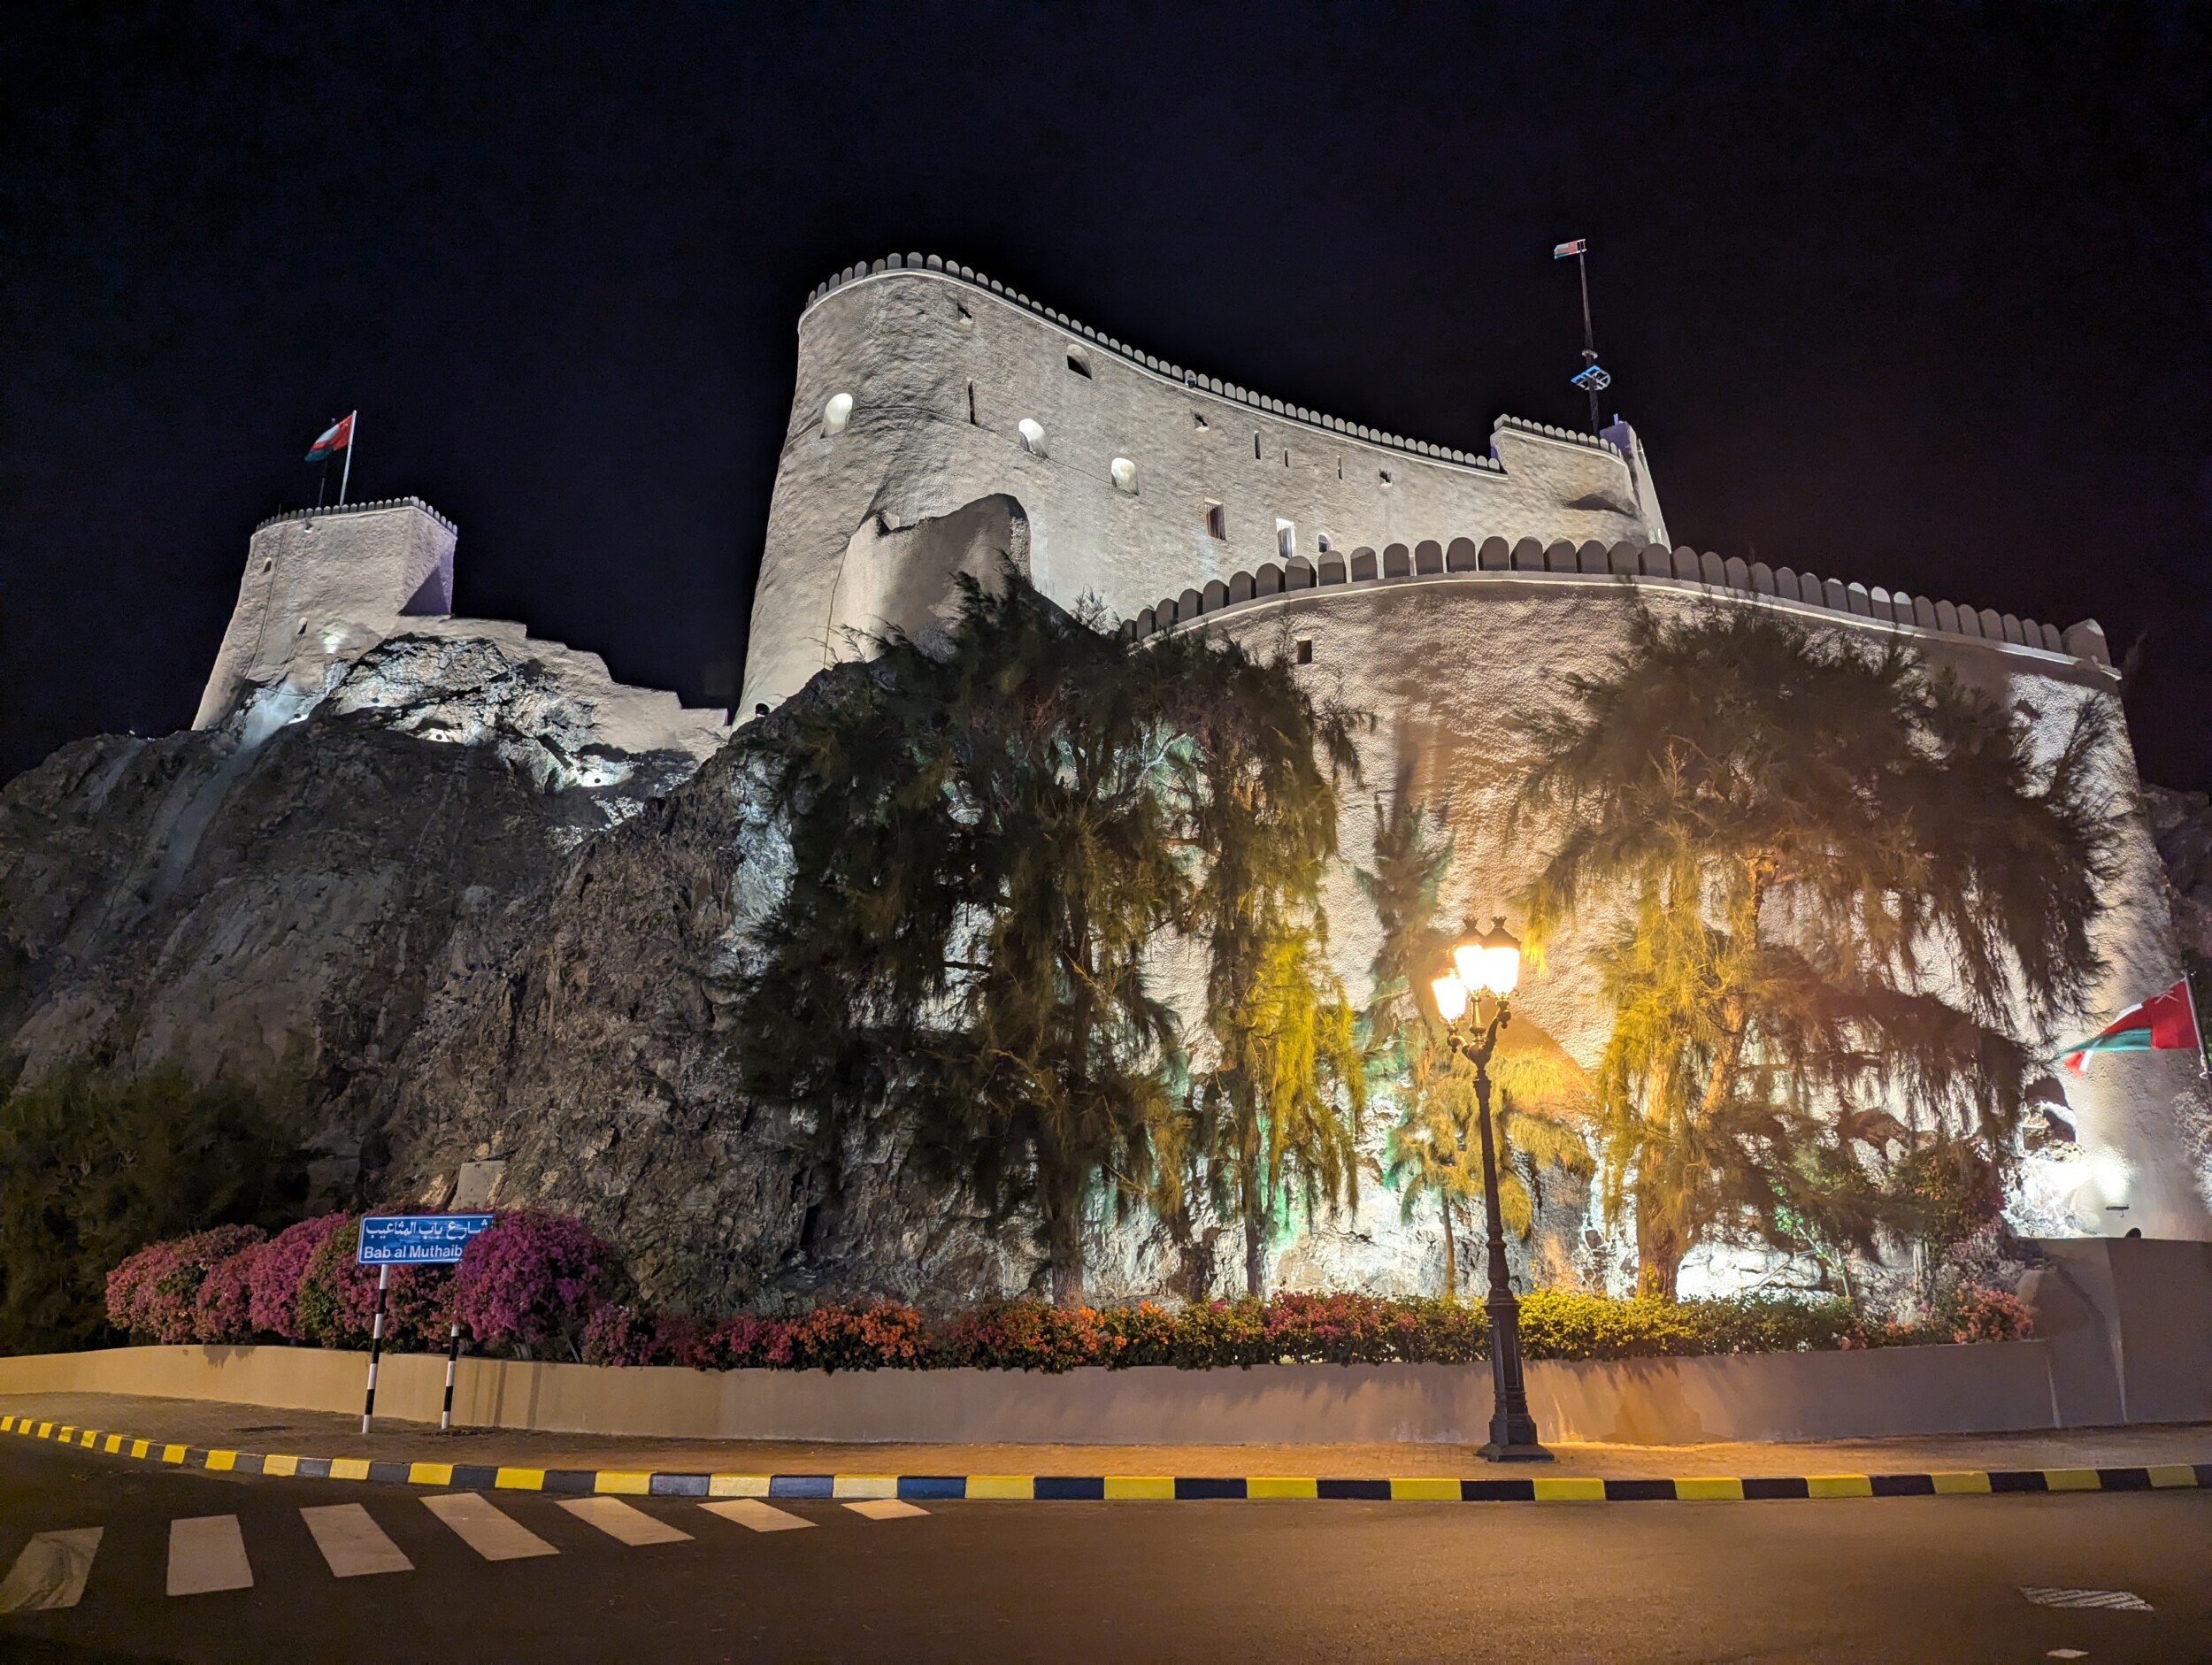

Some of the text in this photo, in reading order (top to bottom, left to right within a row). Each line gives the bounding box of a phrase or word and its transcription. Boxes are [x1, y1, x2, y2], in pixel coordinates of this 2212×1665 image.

[366, 1221, 417, 1239] المثاعيب
[419, 1222, 443, 1239] باب
[364, 1244, 463, 1259] Bab al Muthaib
